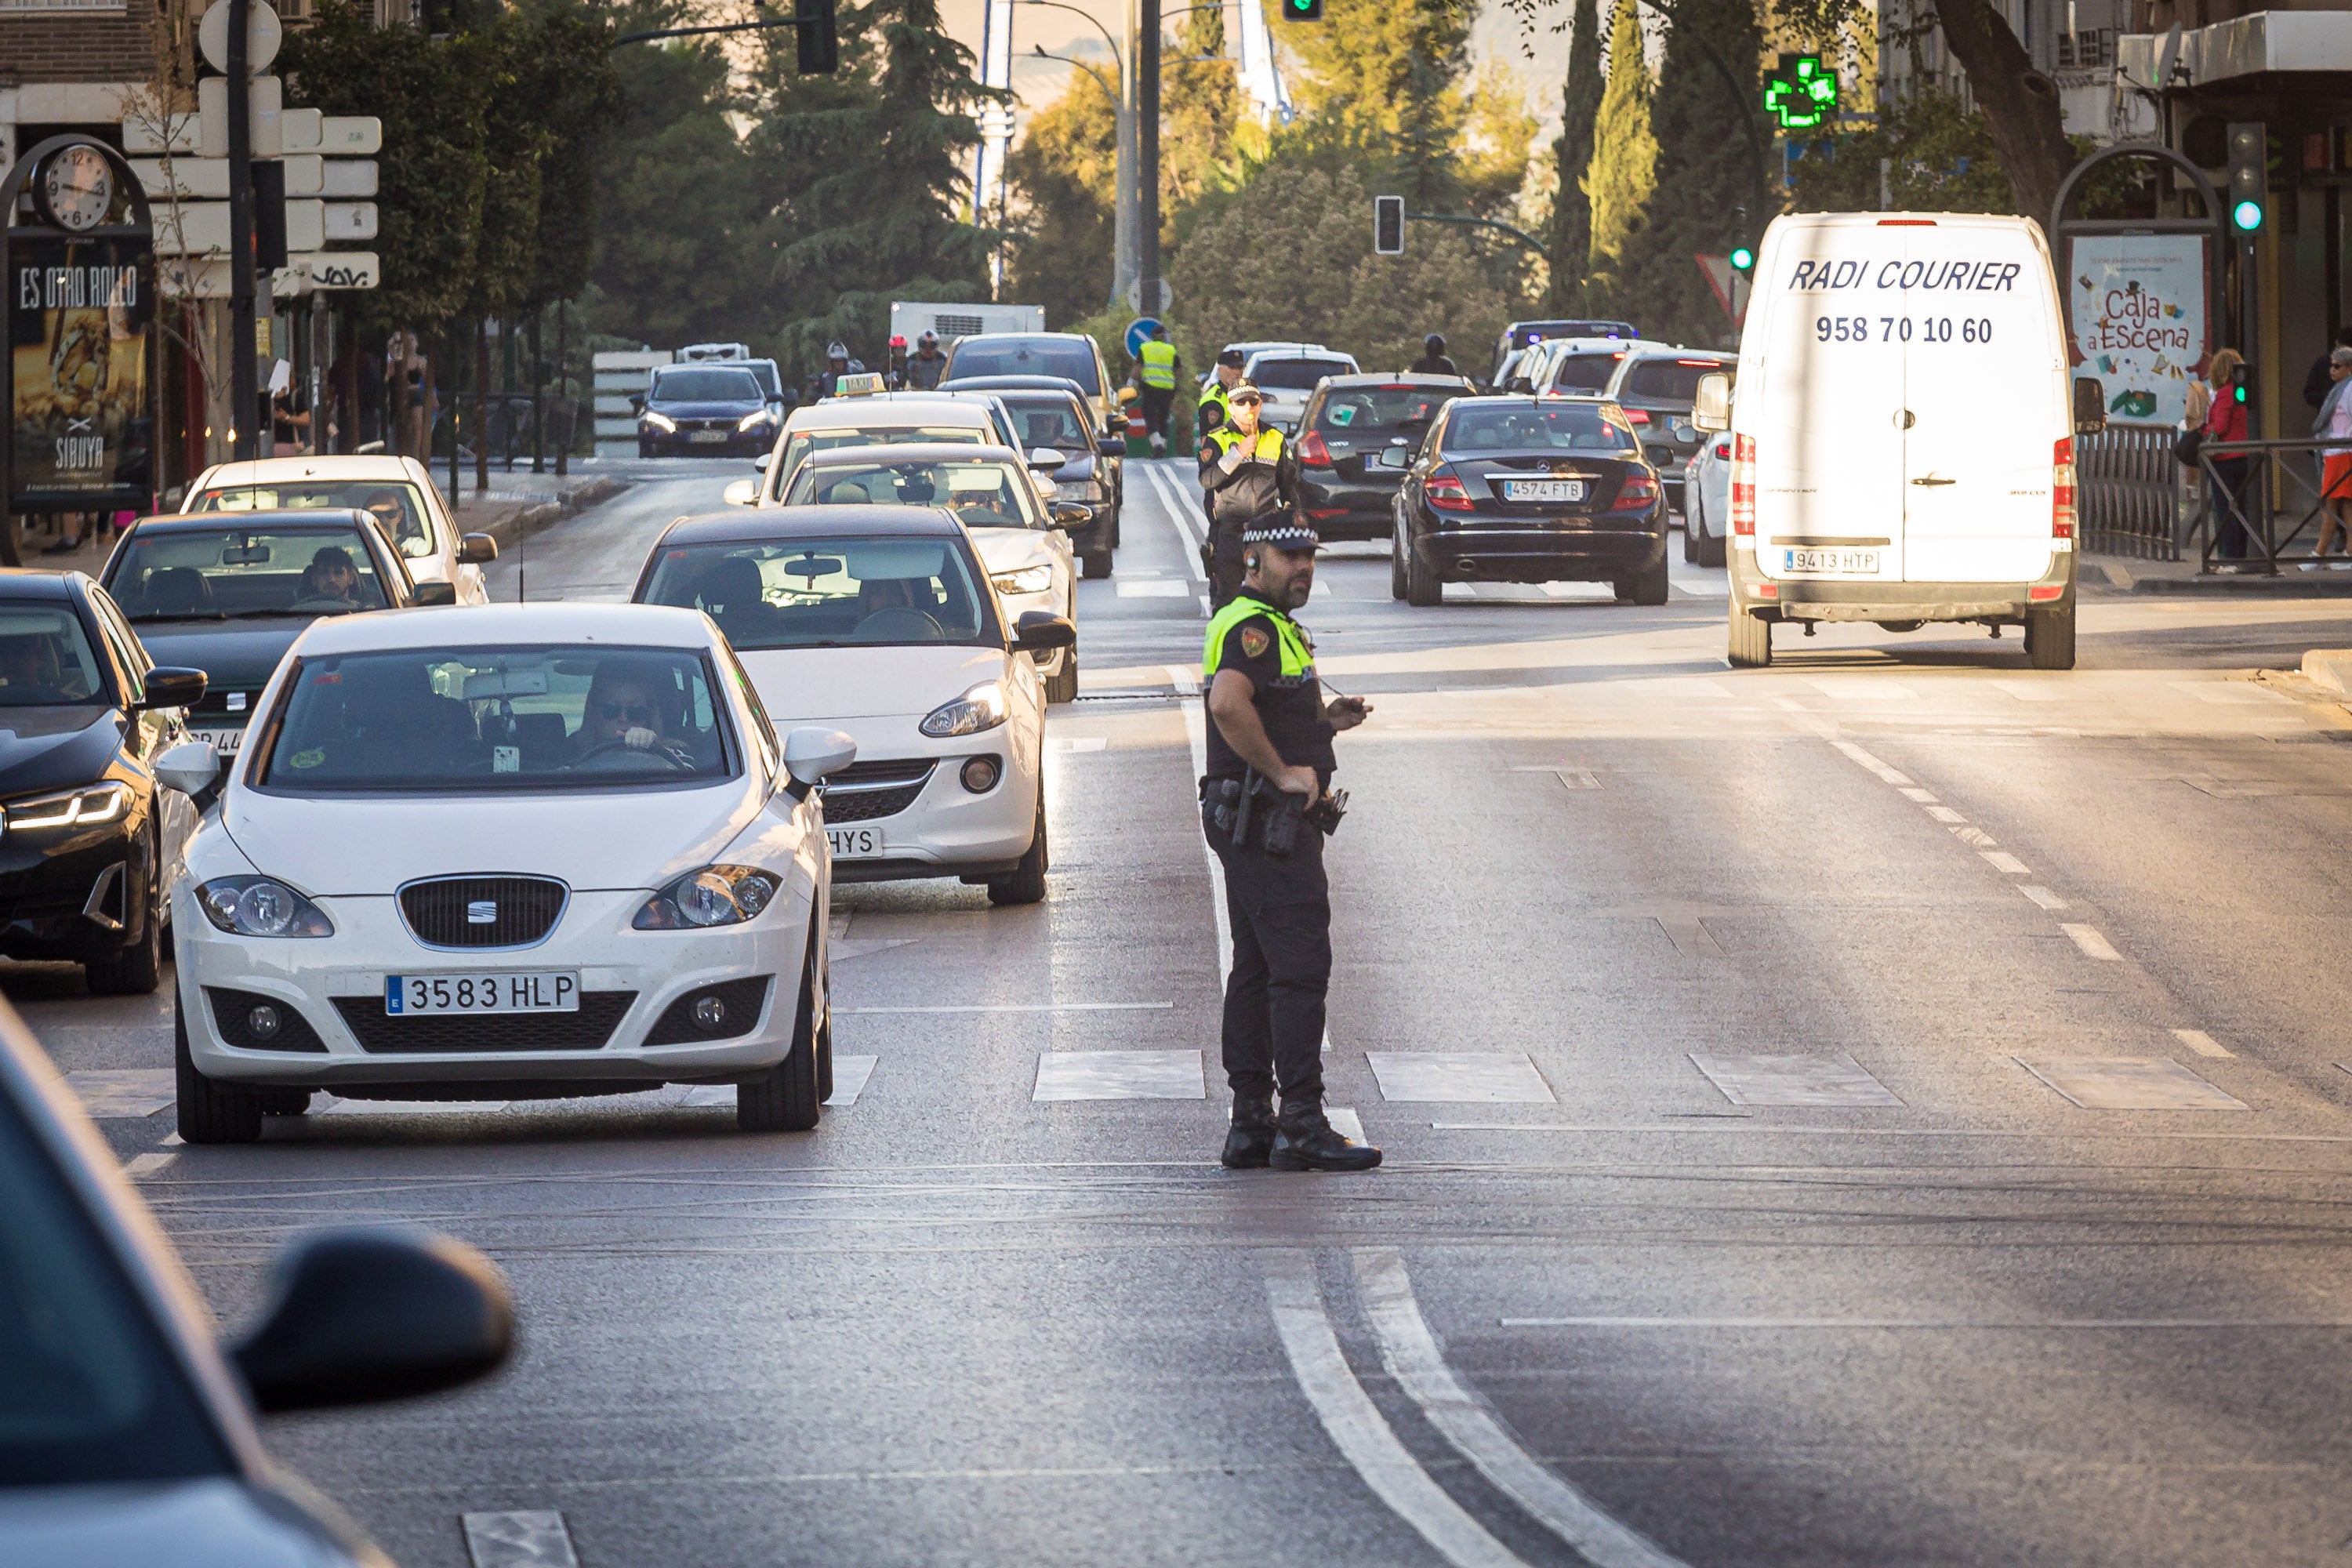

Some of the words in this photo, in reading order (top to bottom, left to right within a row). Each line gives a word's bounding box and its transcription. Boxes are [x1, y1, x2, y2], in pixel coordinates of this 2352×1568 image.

[72, 152, 84, 166] 12
[49, 181, 59, 197] 9
[95, 181, 105, 196] 3
[72, 210, 82, 226] 6
[20, 267, 39, 310] ES
[45, 266, 85, 310] OTRO
[89, 265, 137, 309] ROLLO
[1788, 260, 1870, 291] RADI
[1877, 260, 2021, 292] COURIER
[2106, 288, 2161, 330] Caja
[1817, 316, 1867, 342] 958
[1880, 317, 1912, 343] 70
[1924, 318, 1952, 343] 10
[1962, 318, 1992, 343] 60
[2088, 335, 2098, 351] a
[2100, 320, 2190, 353] Escena
[55, 436, 104, 470] SIBUYA
[1512, 482, 1547, 496] 4574
[1552, 483, 1579, 497] FTB
[1796, 553, 1837, 569] 9413
[1844, 554, 1875, 569] HTP
[392, 999, 399, 1007] E
[411, 978, 498, 1010] 3583
[511, 975, 573, 1007] HLP
